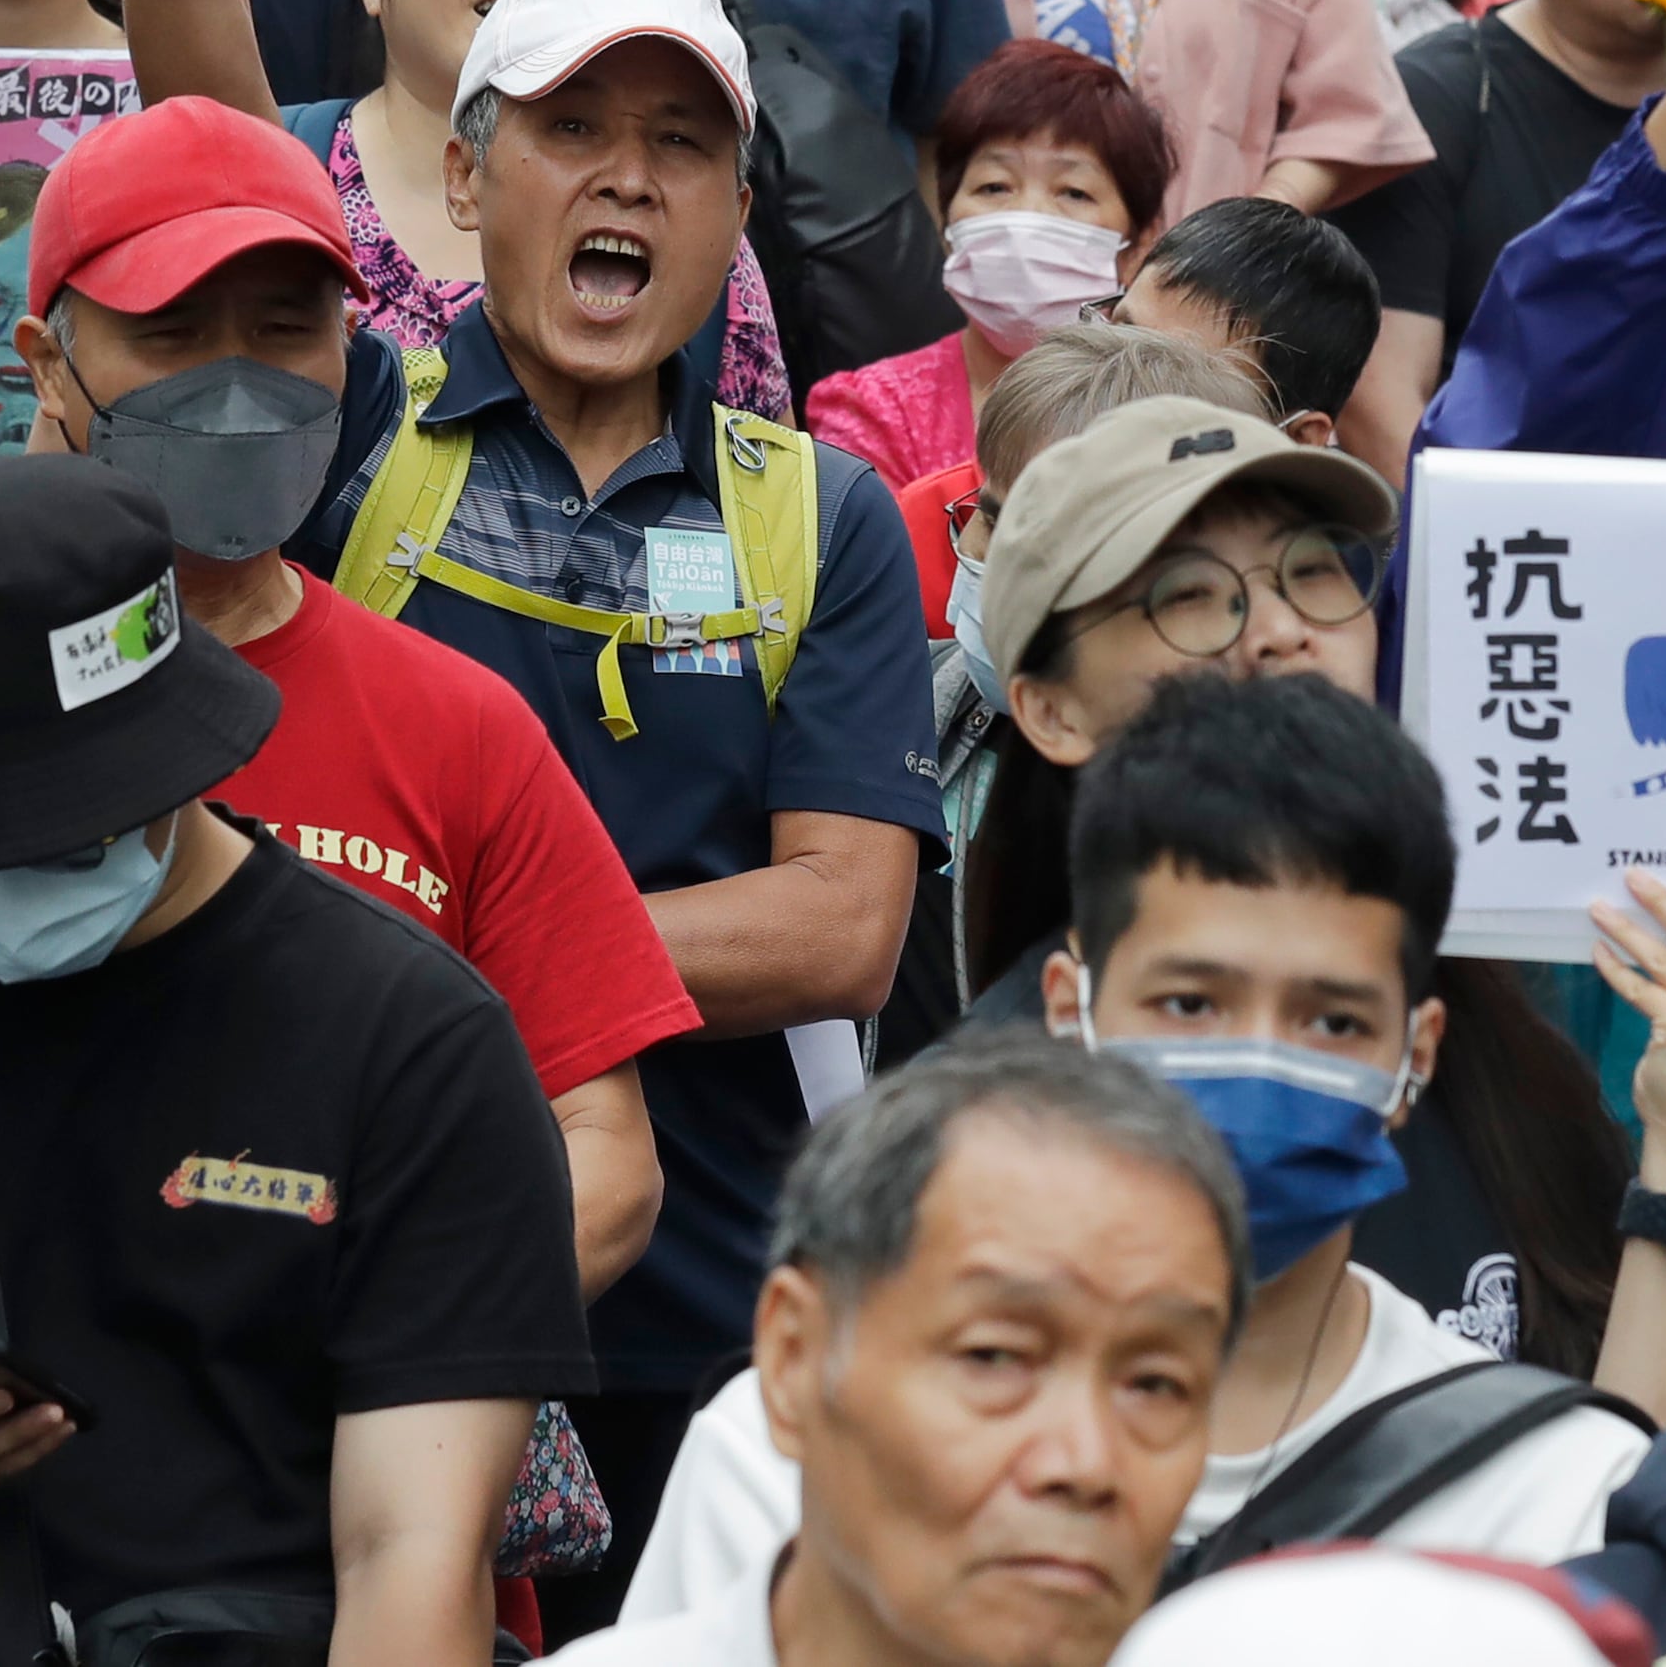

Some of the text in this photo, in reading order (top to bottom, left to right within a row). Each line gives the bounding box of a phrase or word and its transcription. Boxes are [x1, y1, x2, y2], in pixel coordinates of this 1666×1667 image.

[653, 542, 724, 564] 自由台灣
[1465, 530, 1583, 847] 抗惡法
[297, 824, 449, 915] HOLE
